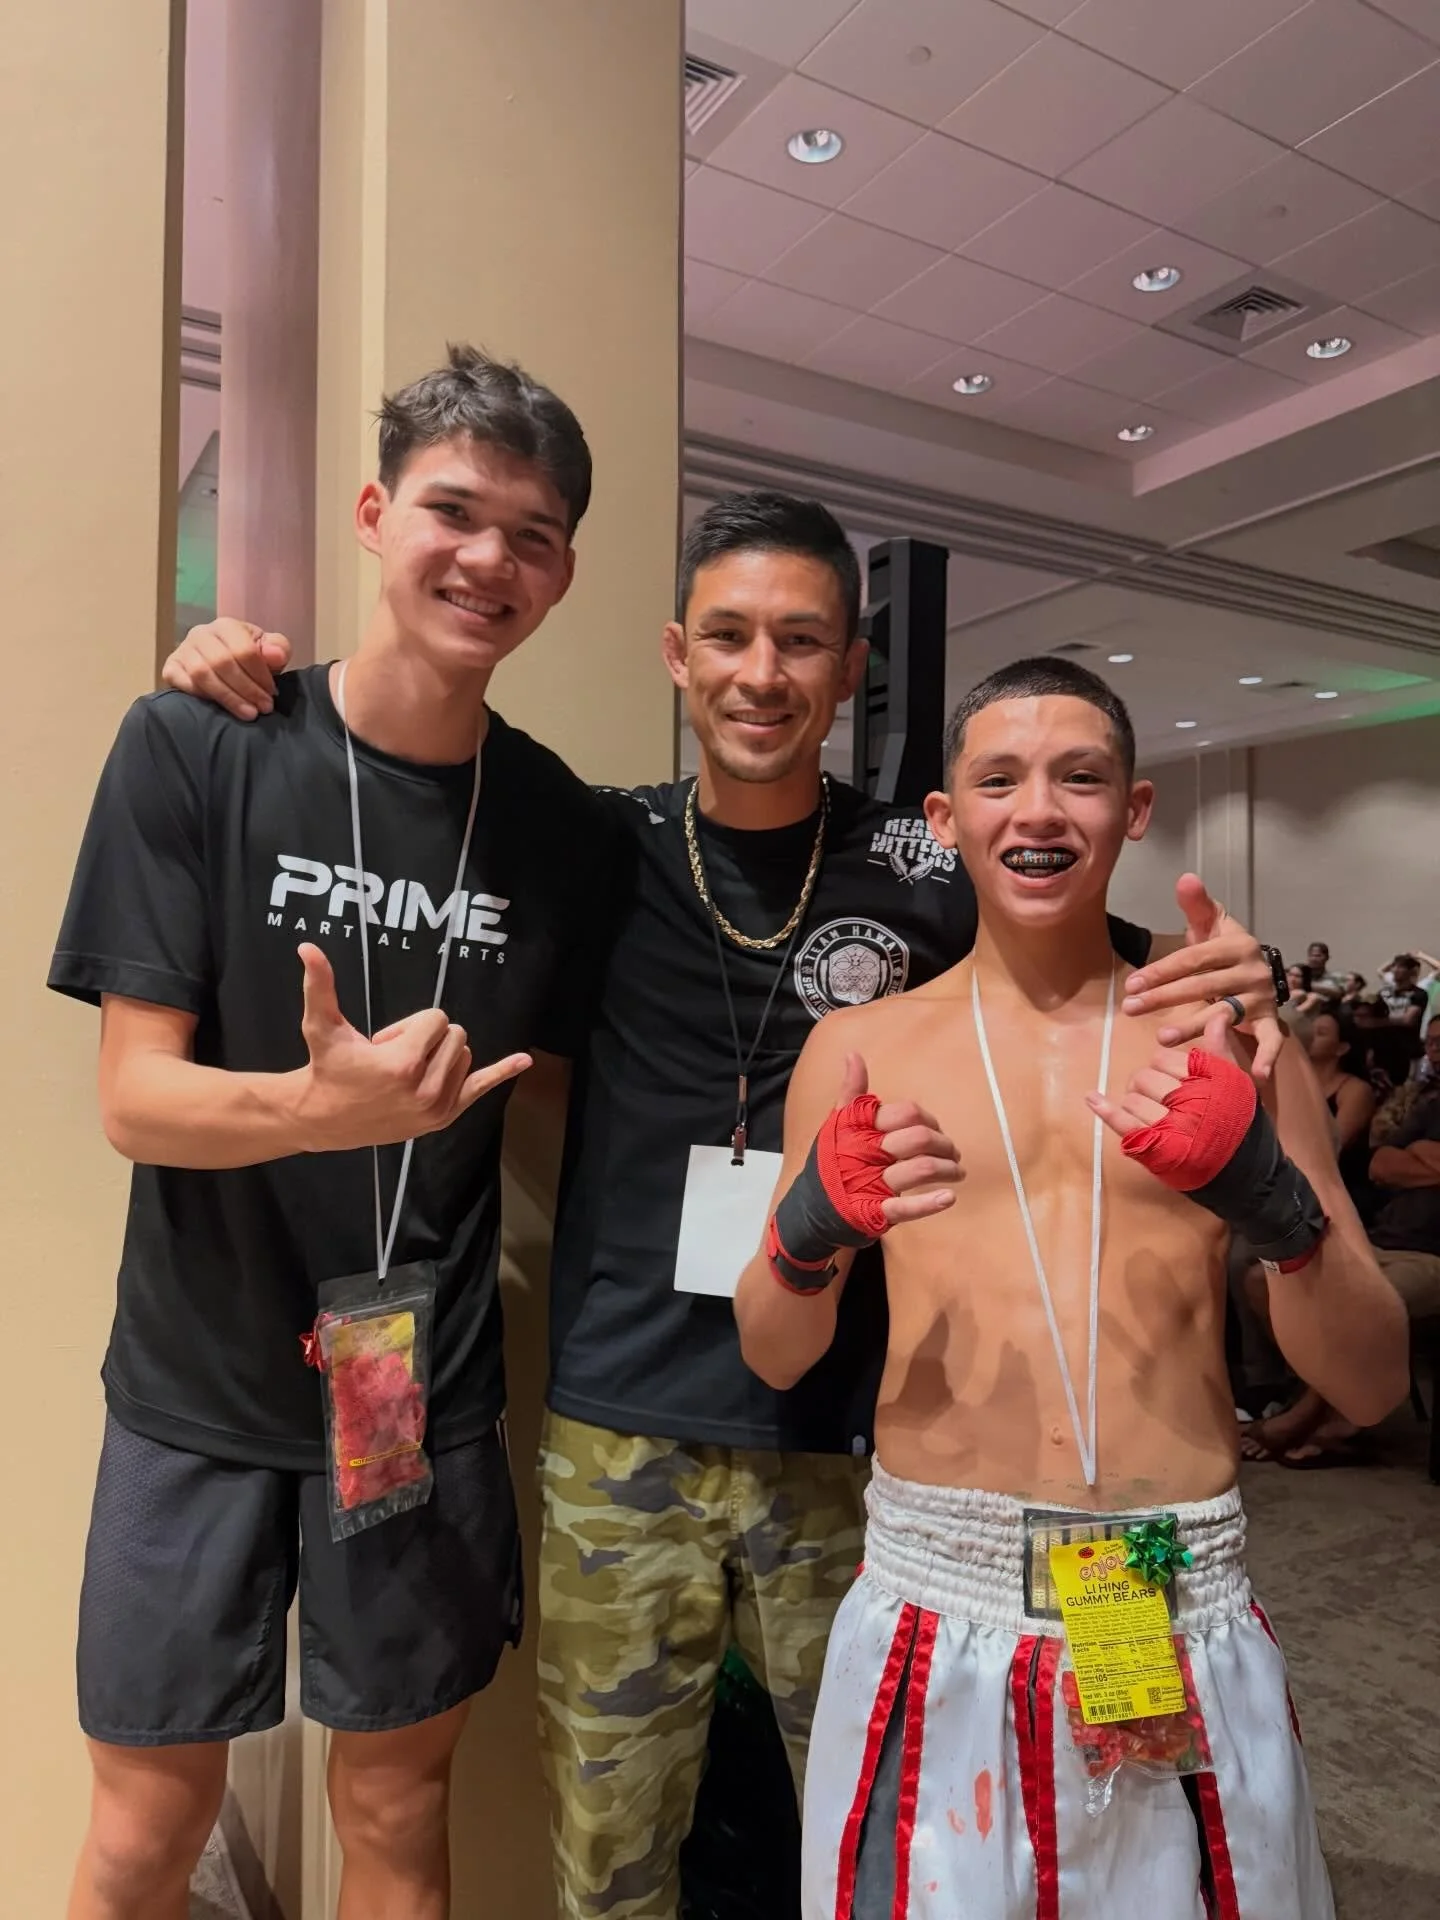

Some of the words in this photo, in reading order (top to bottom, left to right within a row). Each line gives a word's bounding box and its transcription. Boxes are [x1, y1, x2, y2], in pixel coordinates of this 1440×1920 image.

[870, 832, 958, 872] HITTERS
[269, 854, 511, 945] PRIME
[267, 912, 411, 950] MARTAL
[804, 929, 841, 961] TEAM
[852, 925, 902, 965] HAWAII
[1066, 1593, 1110, 1607] GUMMY
[1113, 1587, 1157, 1603] BEARS
[1084, 1583, 1096, 1595] LI
[1098, 1580, 1130, 1594] HING
